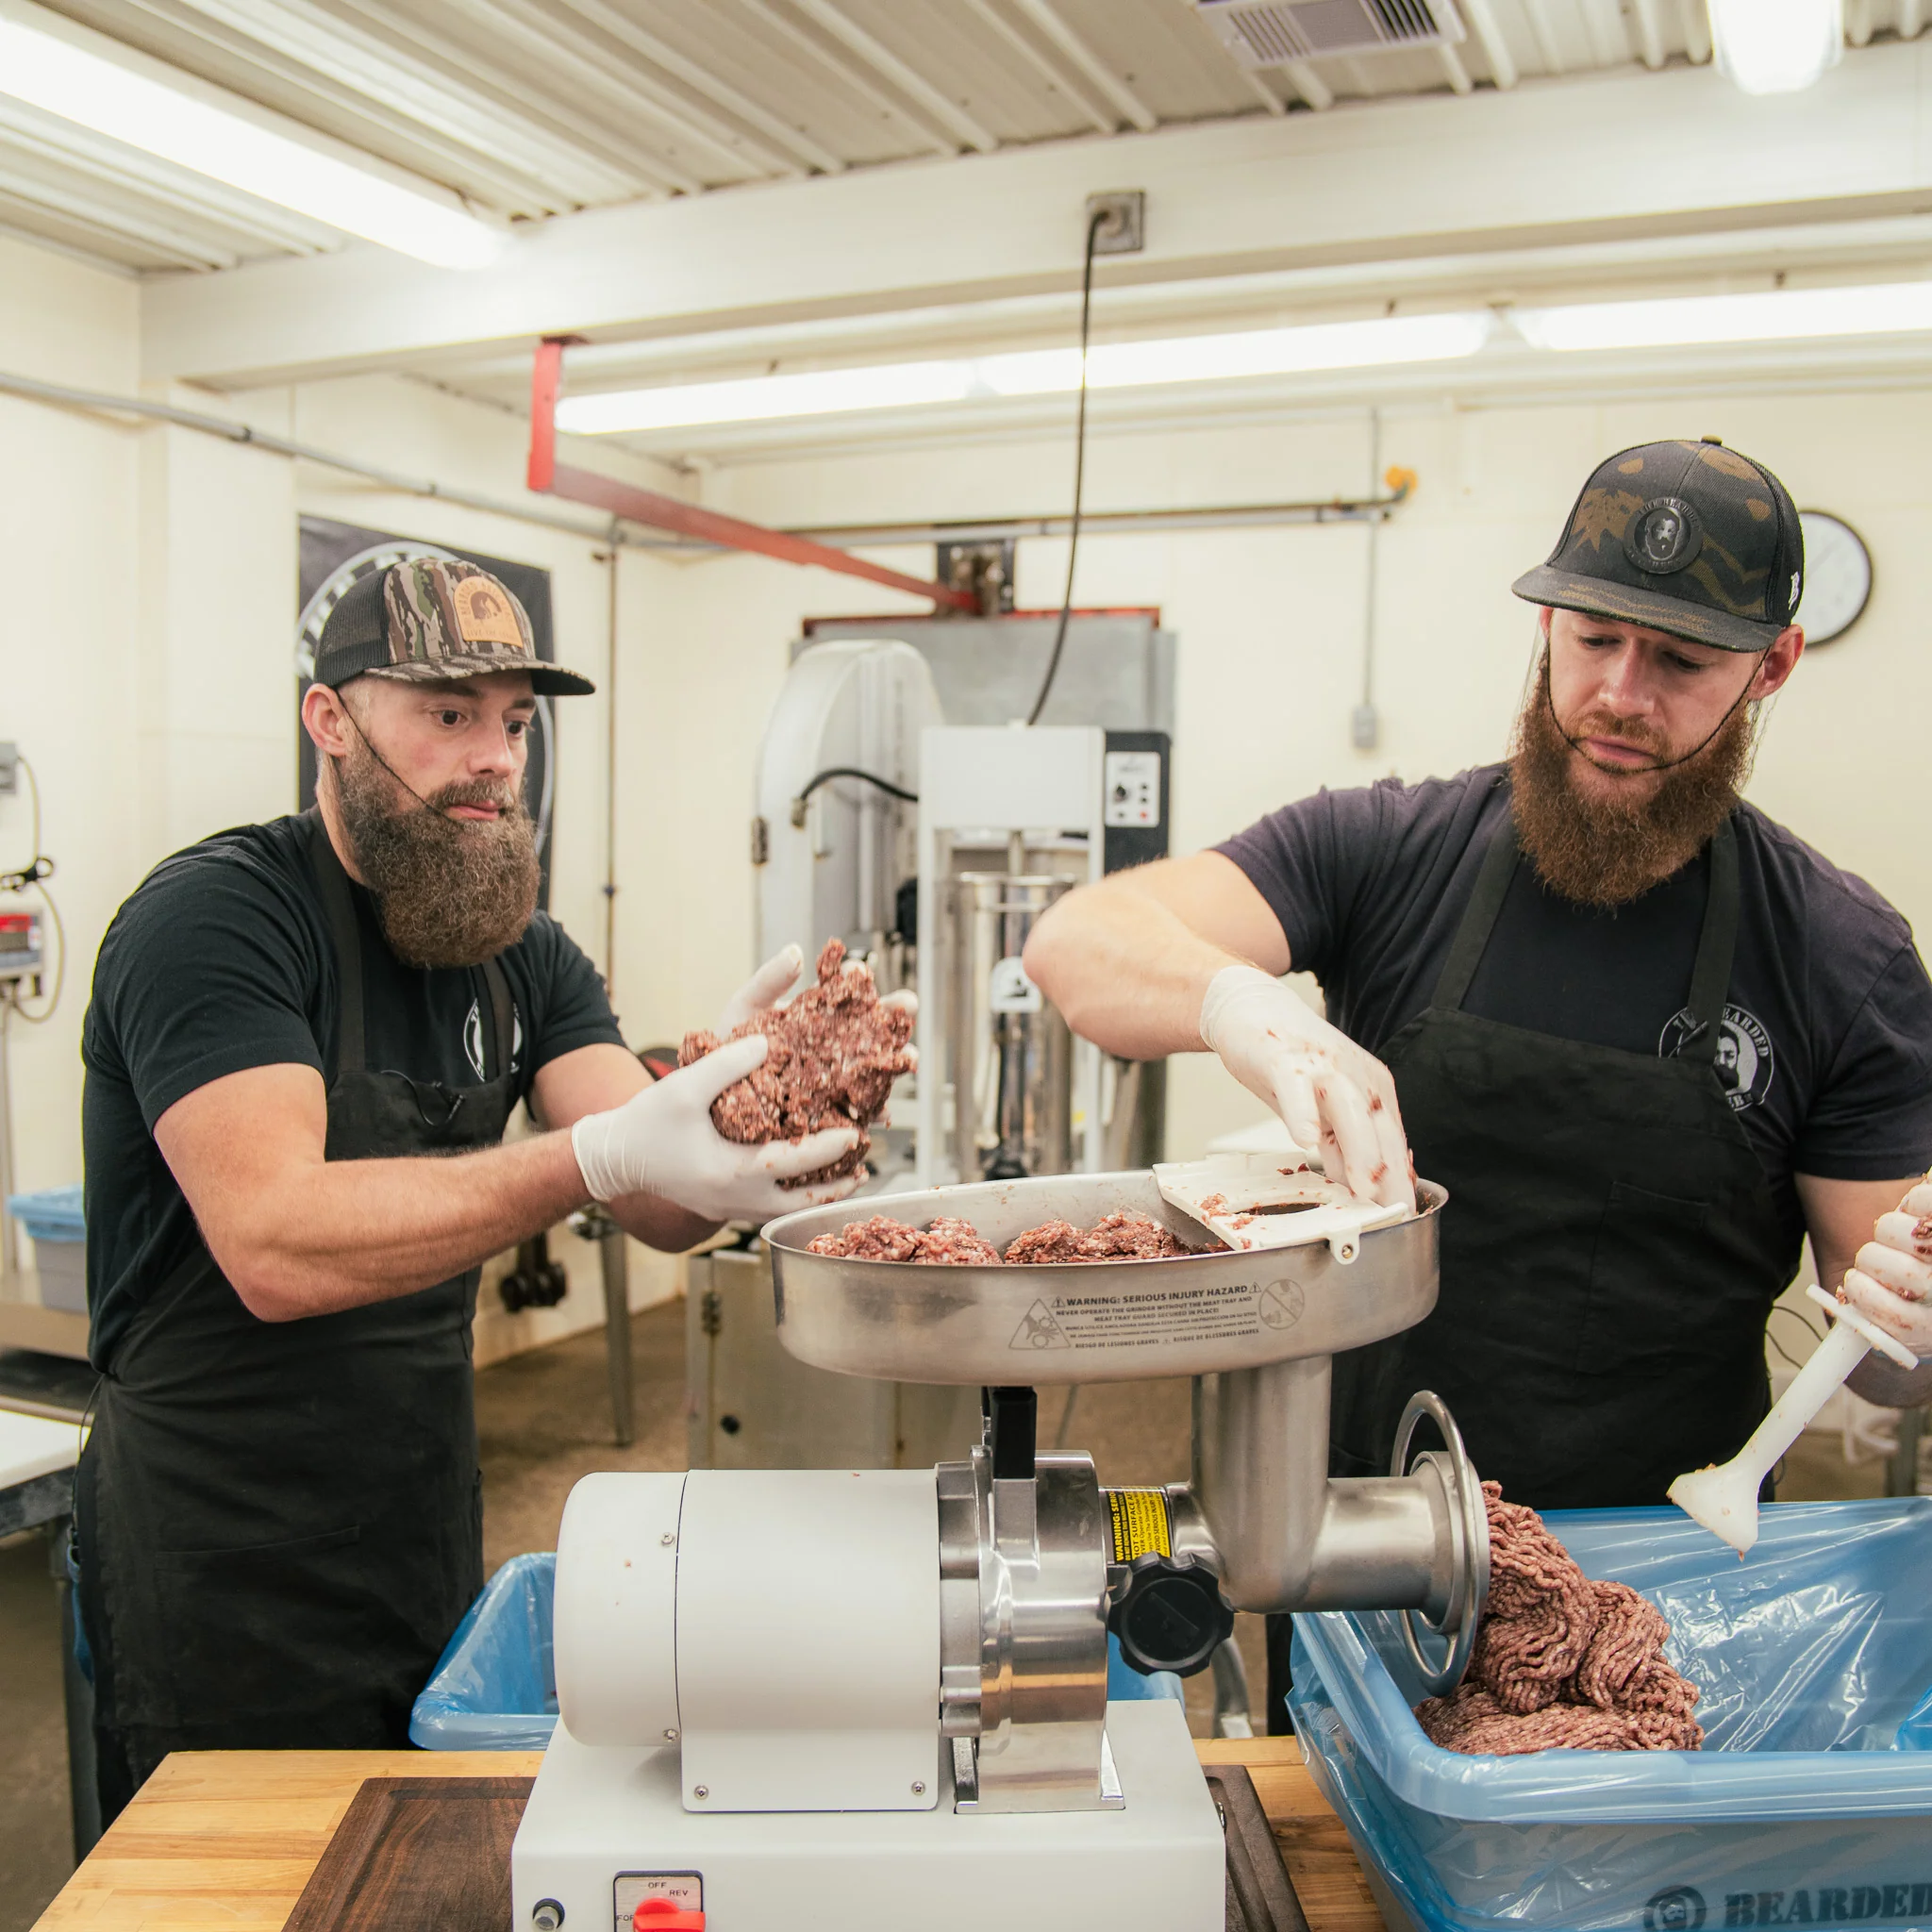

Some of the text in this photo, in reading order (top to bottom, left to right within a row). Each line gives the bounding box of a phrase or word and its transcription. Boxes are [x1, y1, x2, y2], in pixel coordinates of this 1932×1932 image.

[1723, 1008, 1769, 1058] EARDED
[1066, 1285, 1247, 1307] WARNING: SERIOUS INJURY HAZARD
[1108, 1491, 1124, 1561] WARNING: SERIO
[1128, 1501, 1139, 1538] SURFACE
[1137, 1516, 1145, 1539] Operate
[1724, 1883, 1932, 1928] BEARDED
